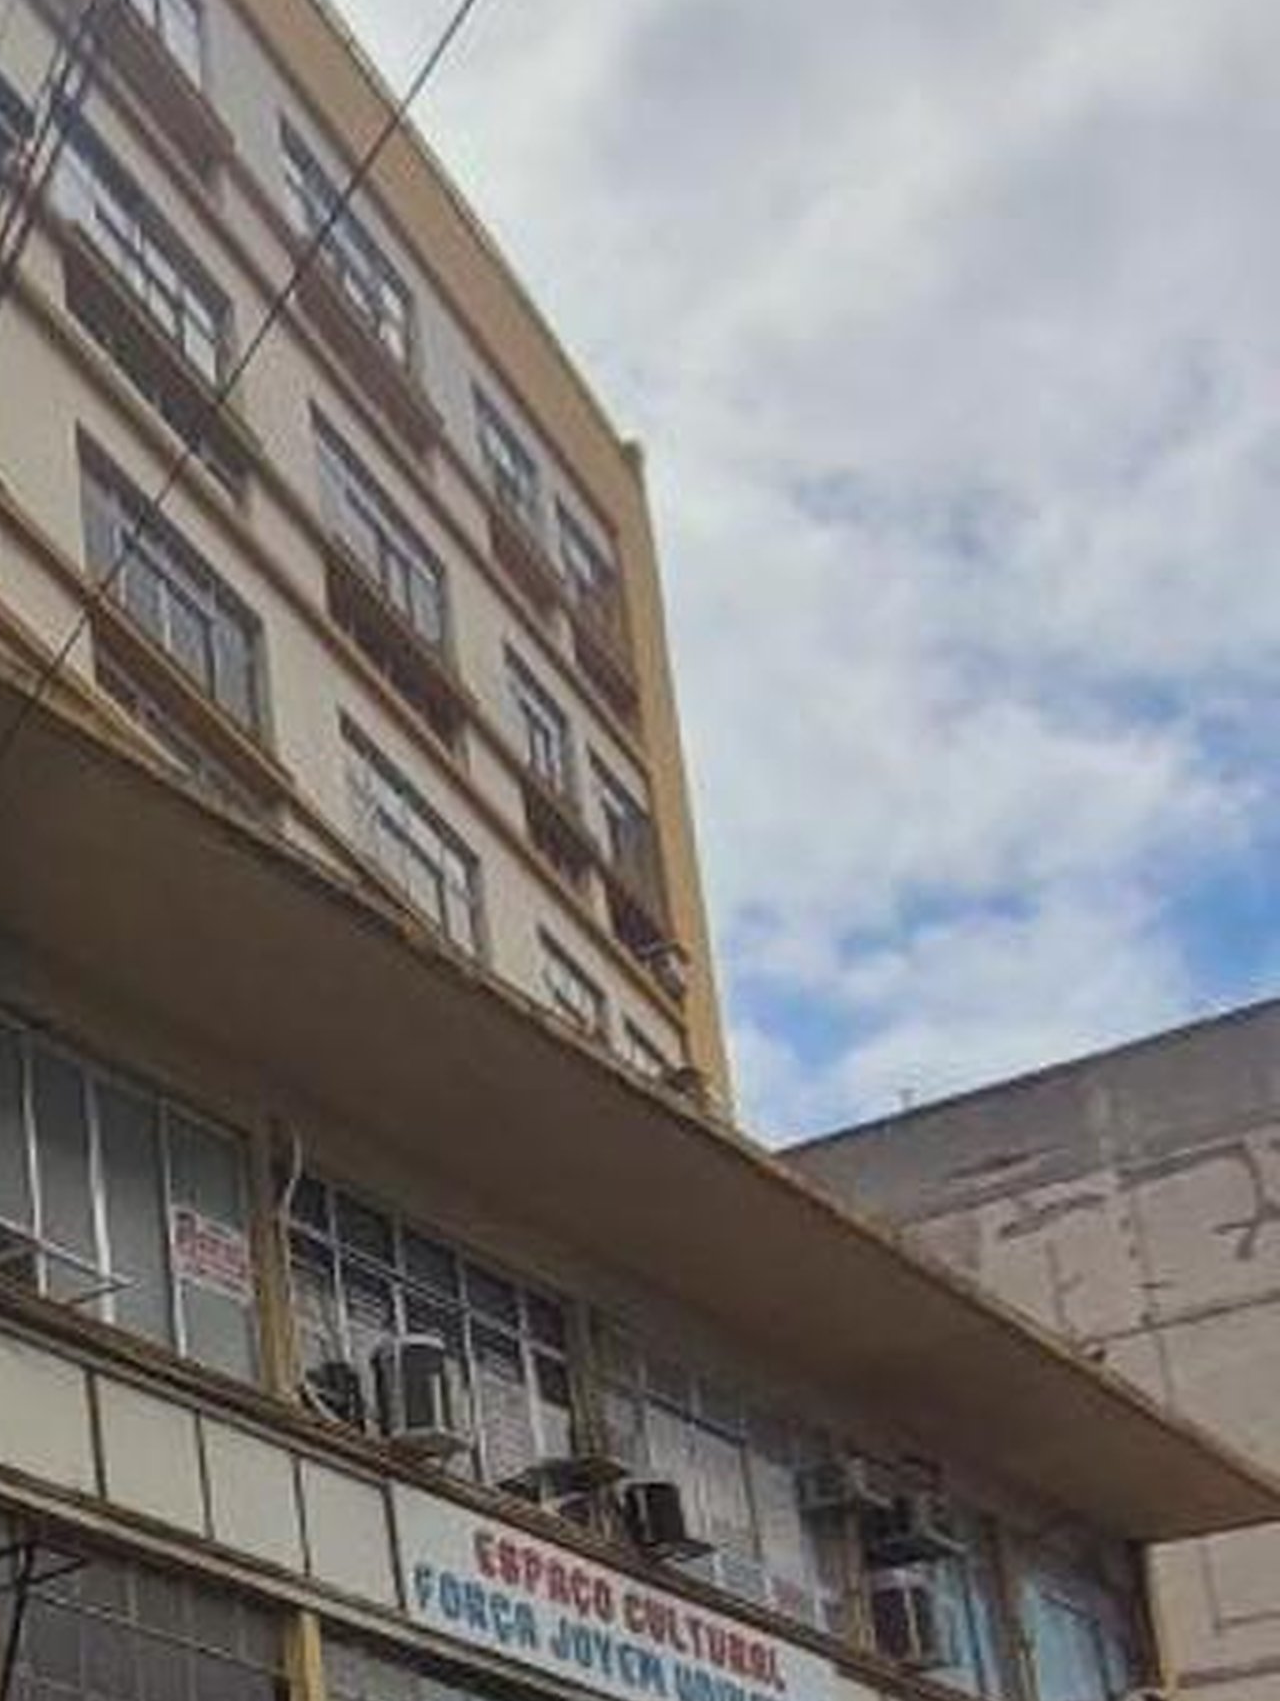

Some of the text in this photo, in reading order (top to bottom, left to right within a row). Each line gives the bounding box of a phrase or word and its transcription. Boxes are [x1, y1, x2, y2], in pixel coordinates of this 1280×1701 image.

[413, 1563, 537, 1650] FORÇA
[473, 1529, 786, 1692] ESPAÇO CULTURAL
